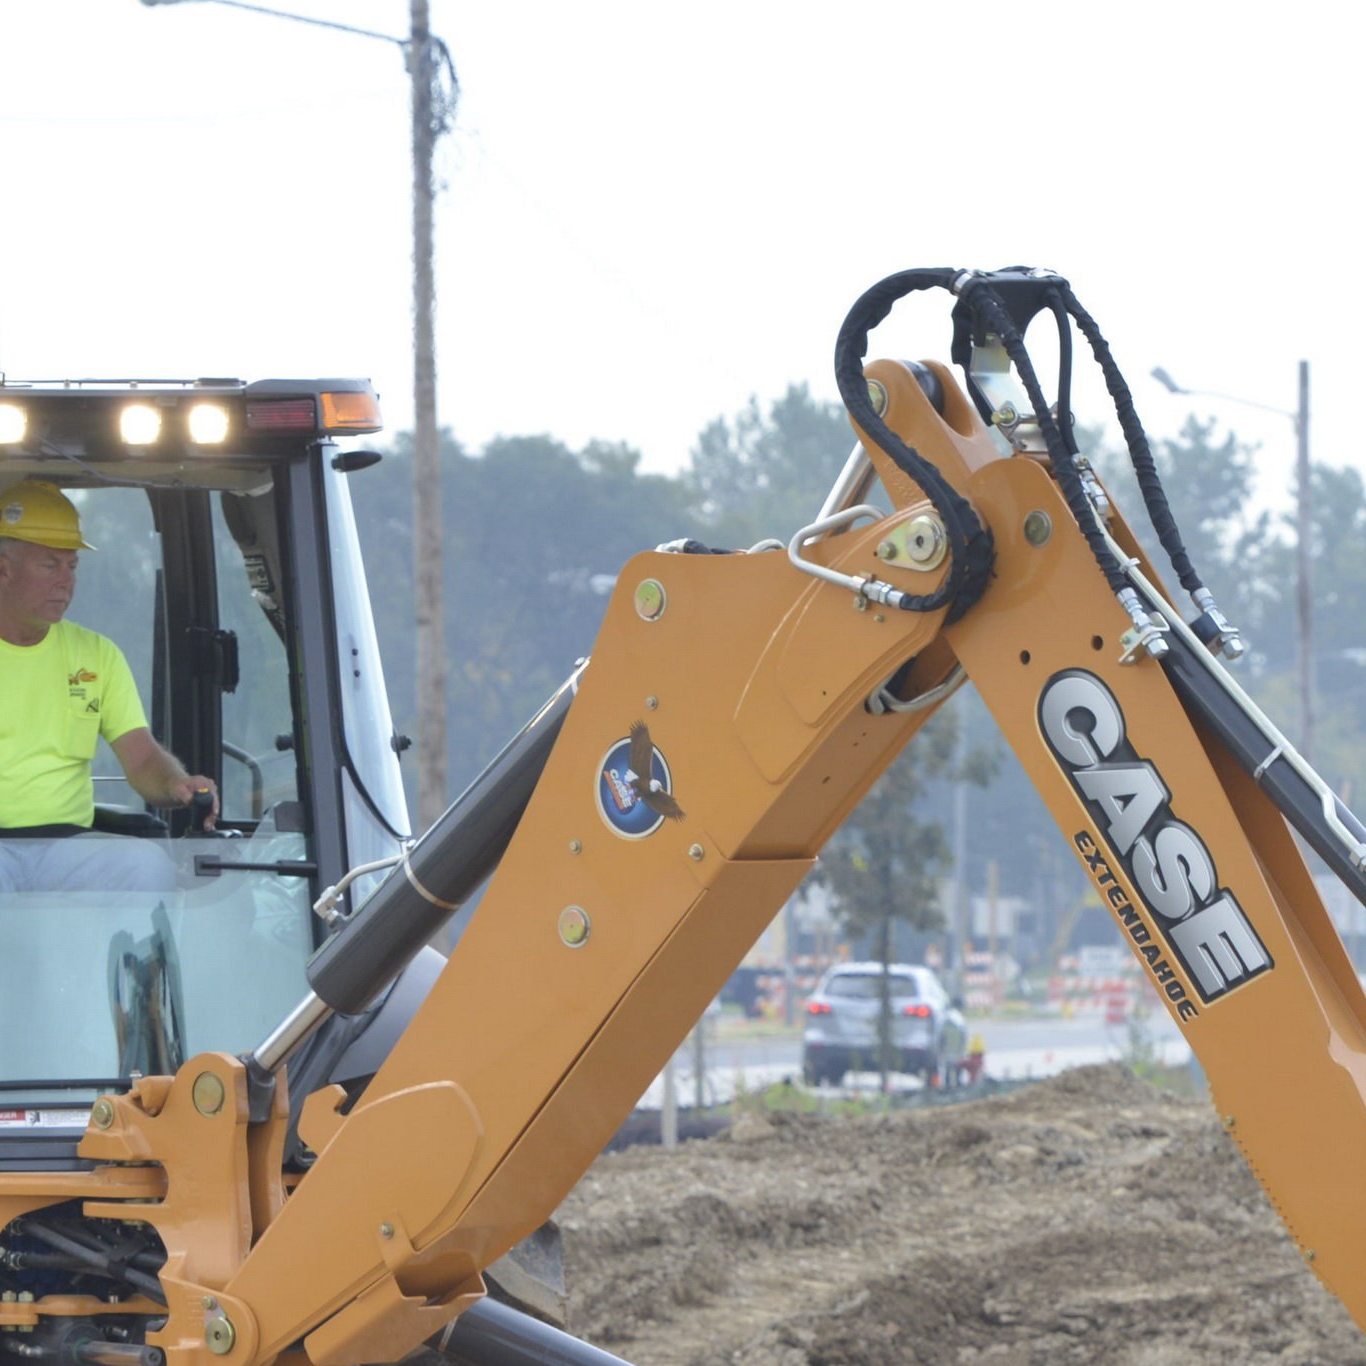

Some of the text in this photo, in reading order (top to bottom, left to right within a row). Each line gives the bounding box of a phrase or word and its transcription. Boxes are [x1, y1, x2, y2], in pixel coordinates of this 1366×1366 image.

[609, 768, 633, 809] CASE
[1038, 672, 1270, 1000] CASE
[1073, 830, 1200, 1023] EXTENDAHOE
